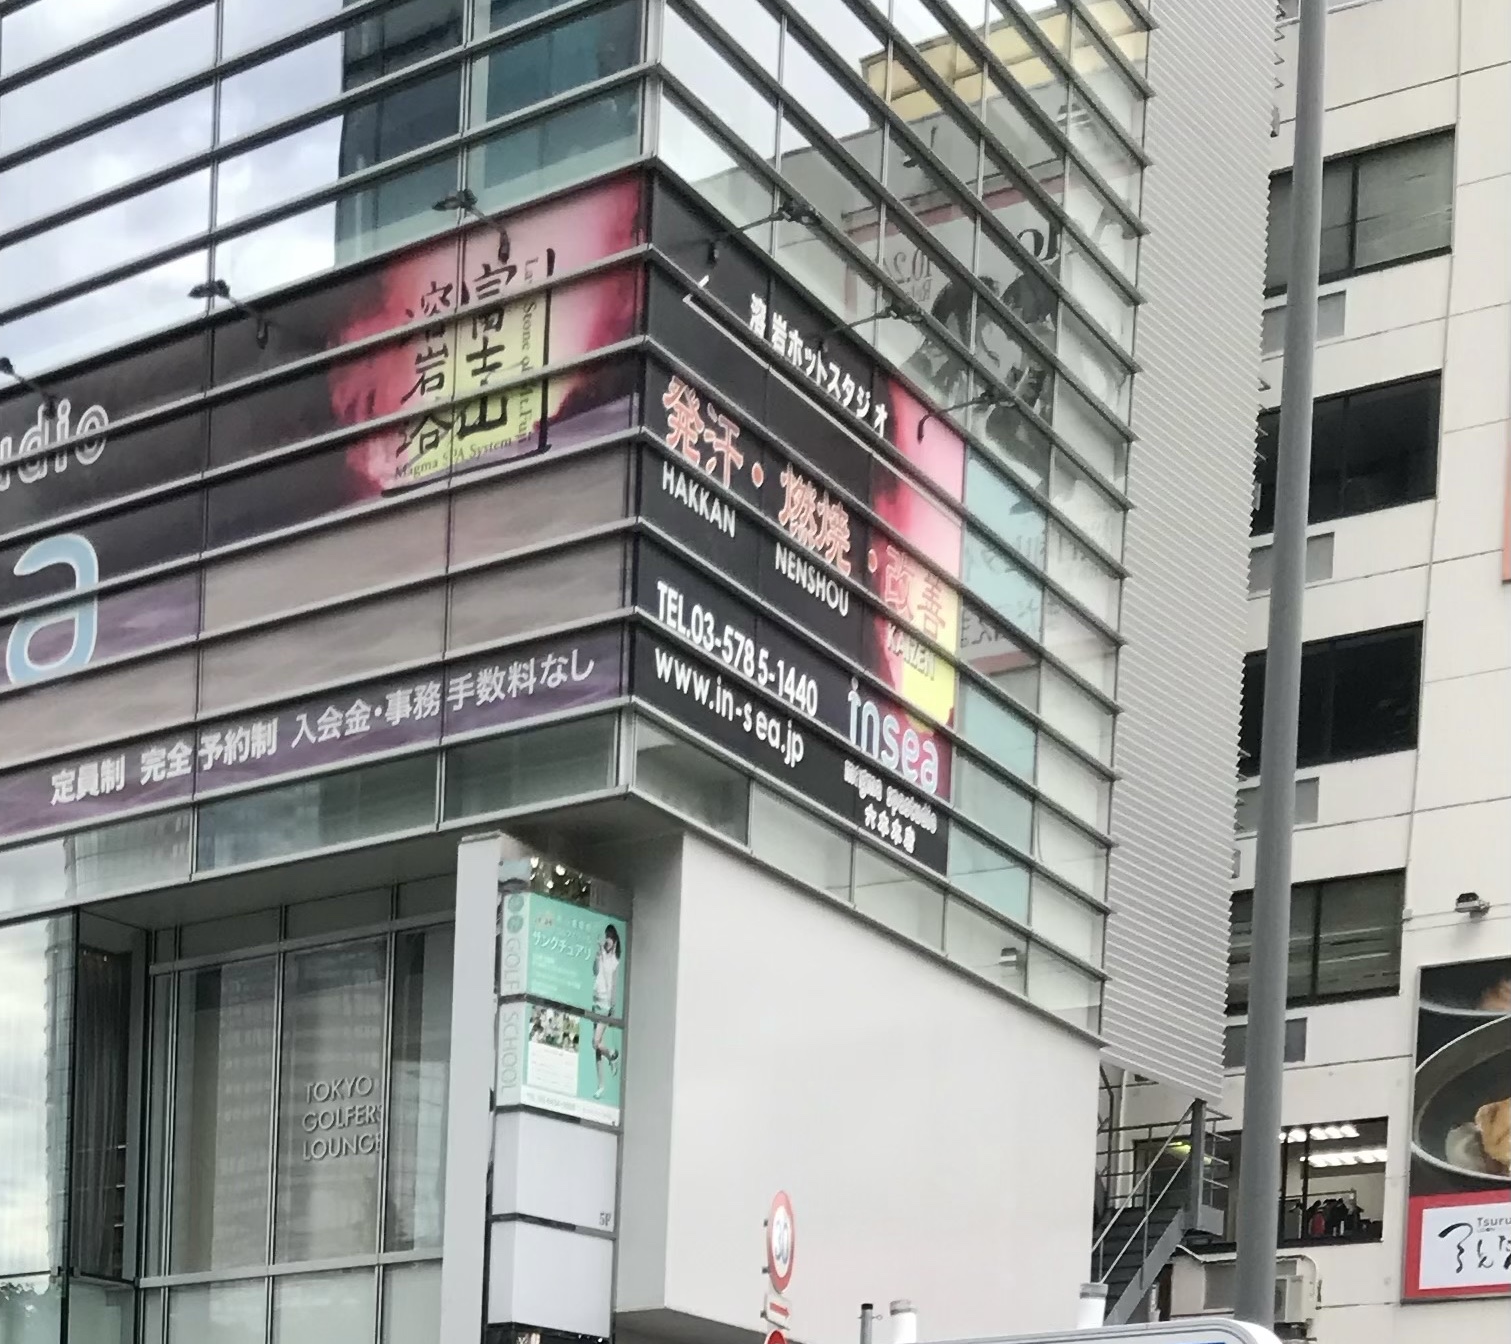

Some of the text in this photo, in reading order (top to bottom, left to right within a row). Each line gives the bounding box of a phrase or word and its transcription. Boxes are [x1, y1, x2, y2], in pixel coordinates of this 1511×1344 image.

[662, 460, 736, 538] HAKKAN
[775, 542, 849, 617] NENSHOU
[50, 648, 595, 806] 定員制 完全予約制 入会金・事務手数料なし
[655, 648, 804, 768] www.in-sea.jp
[848, 676, 938, 794] insea
[503, 938, 520, 991] GOLF
[305, 1076, 373, 1103] TOKYO
[500, 1011, 520, 1093] SCHOOL
